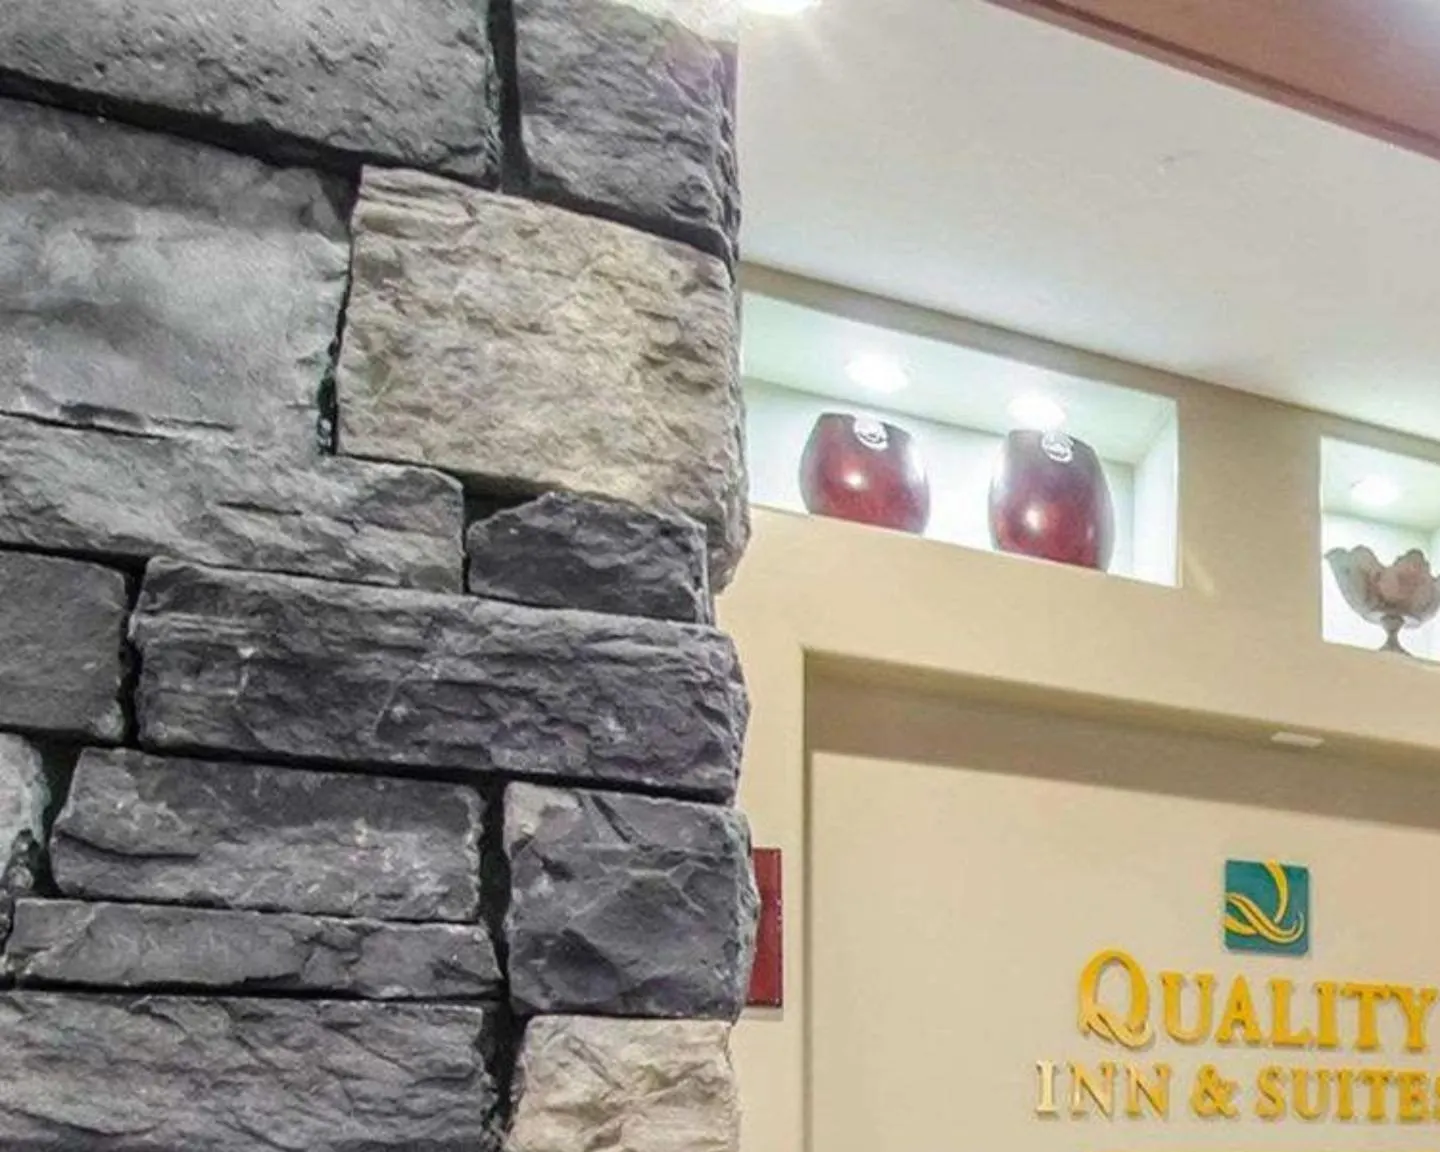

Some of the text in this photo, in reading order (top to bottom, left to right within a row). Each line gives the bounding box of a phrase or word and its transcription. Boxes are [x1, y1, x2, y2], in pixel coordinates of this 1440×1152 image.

[1078, 947, 1440, 1053] QUALITY
[1035, 1059, 1171, 1119] INN
[1191, 1063, 1239, 1118] &
